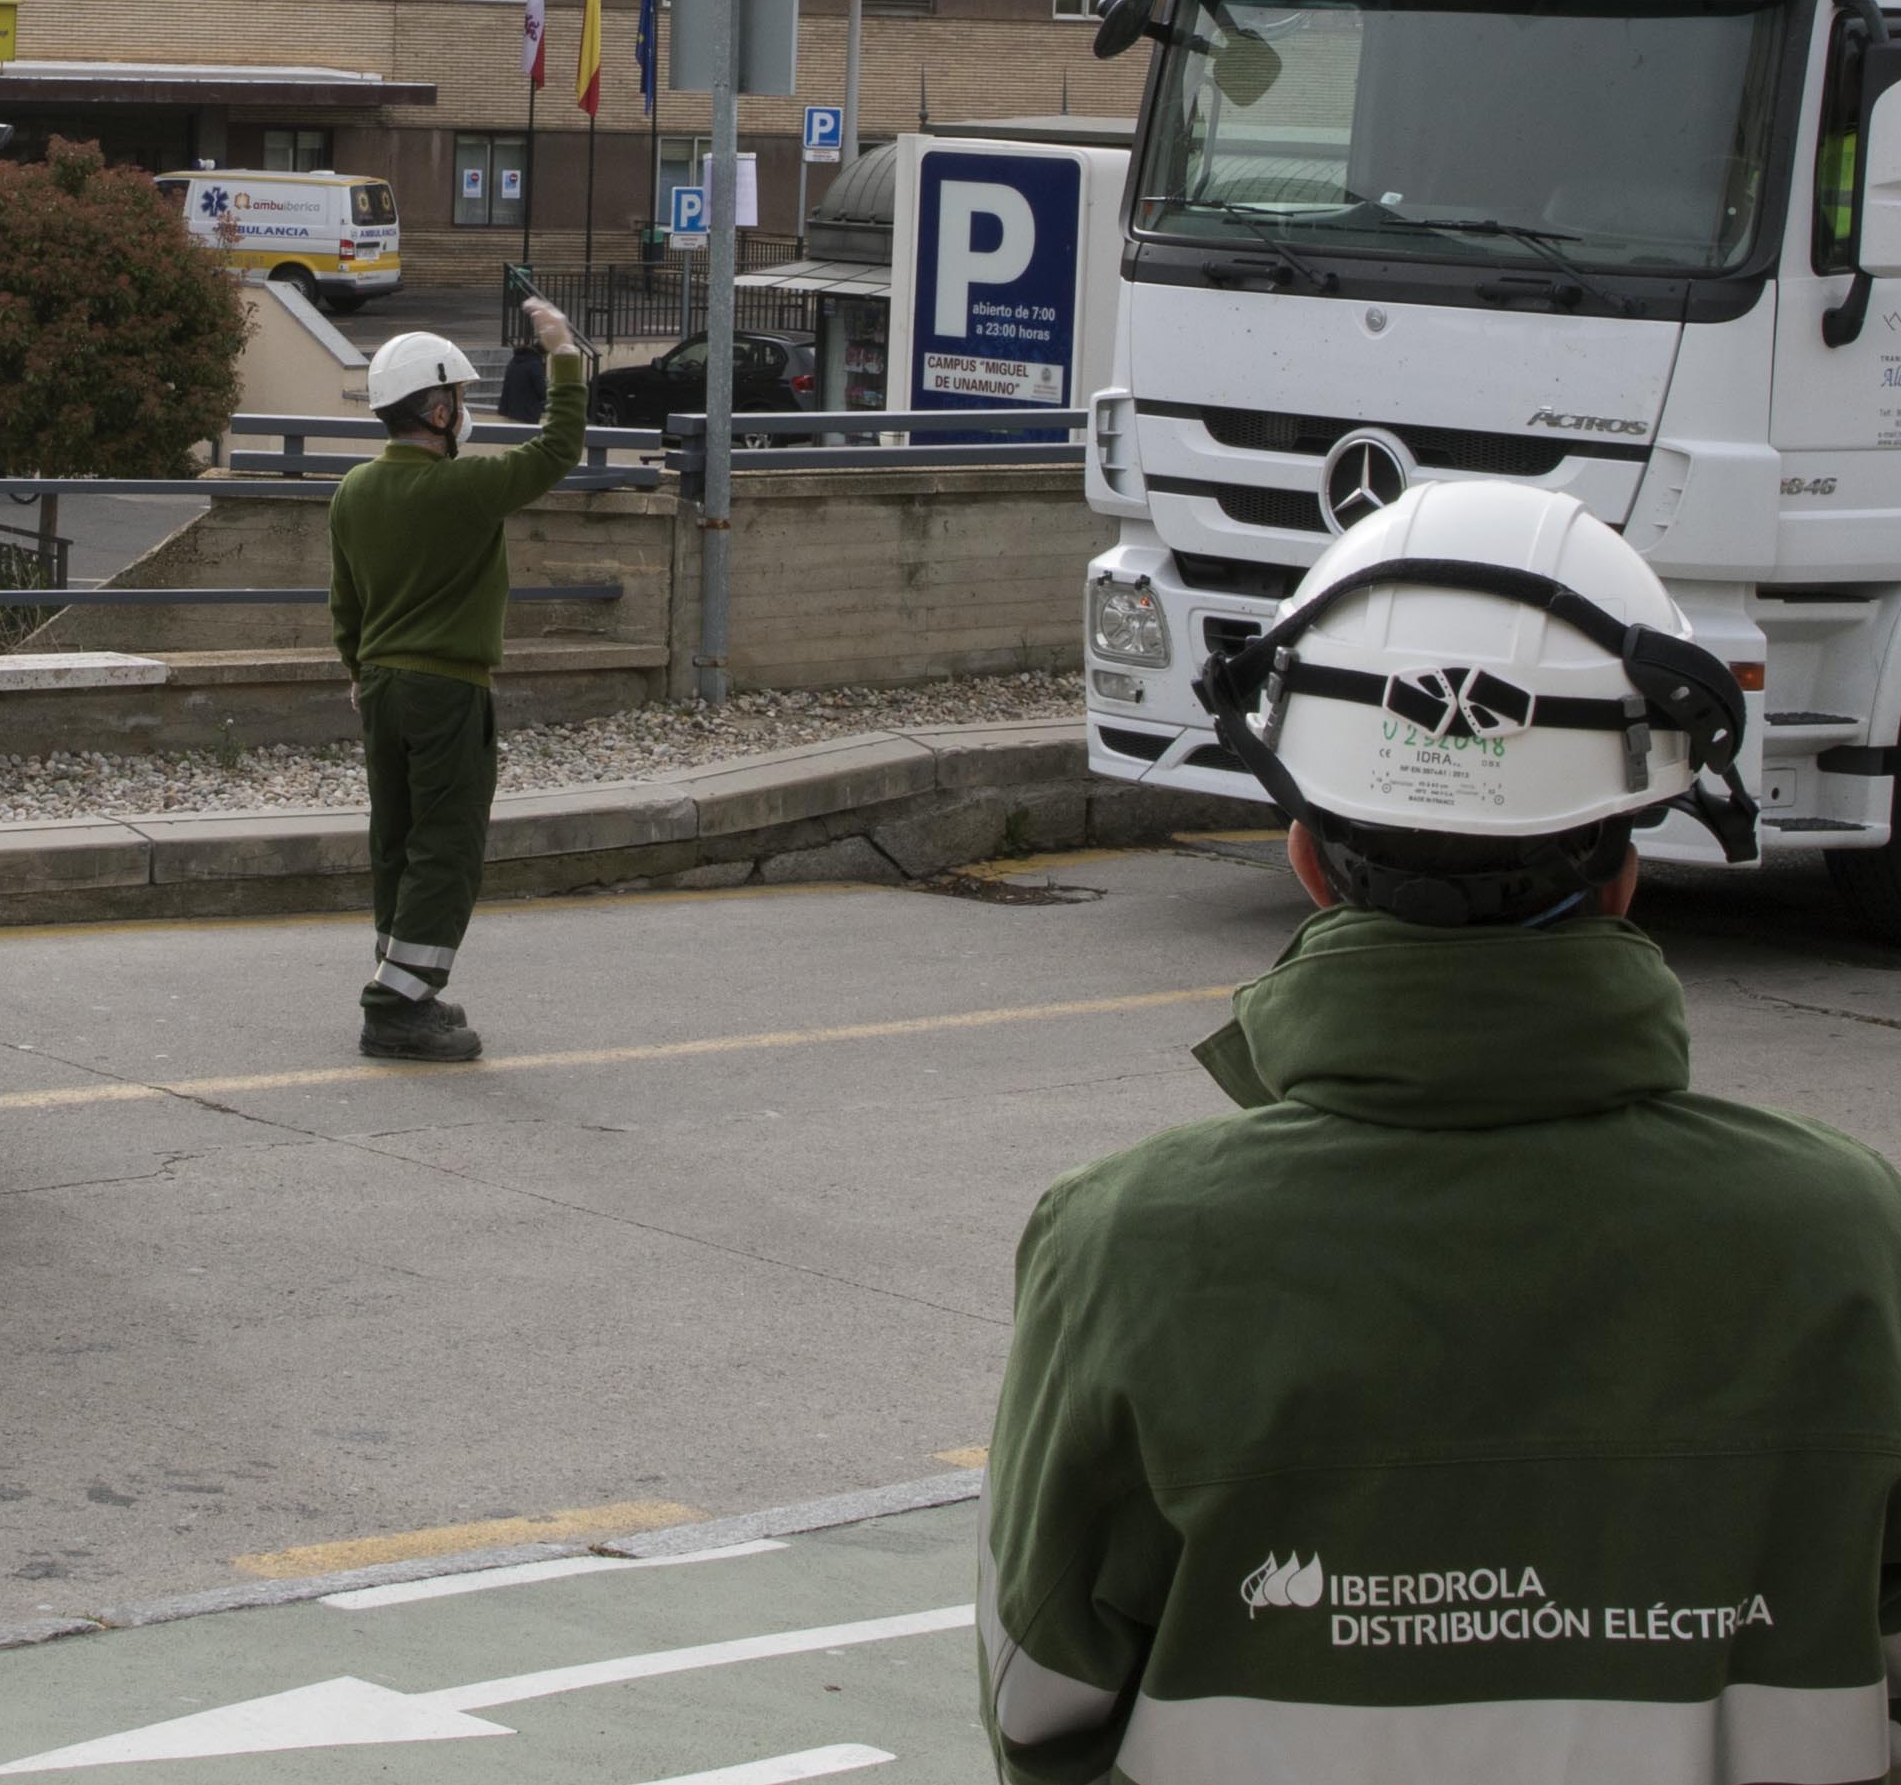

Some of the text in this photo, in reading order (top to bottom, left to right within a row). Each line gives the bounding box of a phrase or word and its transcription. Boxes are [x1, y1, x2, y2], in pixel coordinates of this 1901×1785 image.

[215, 221, 309, 237] ABULANCIA
[934, 180, 1036, 338] P
[972, 301, 1056, 321] abierto de 7:00
[975, 322, 1051, 341] a 23:00 horas
[927, 355, 1030, 378] CAMPUS "MIGUEL
[935, 376, 950, 389] DE
[953, 377, 1021, 396] UNAMUNO"
[1416, 750, 1452, 765] IDRA
[1330, 1566, 1547, 1607] IBERDROLA
[1331, 1593, 1774, 1646] DISTRIBUCIÓN ELÉCTRA
